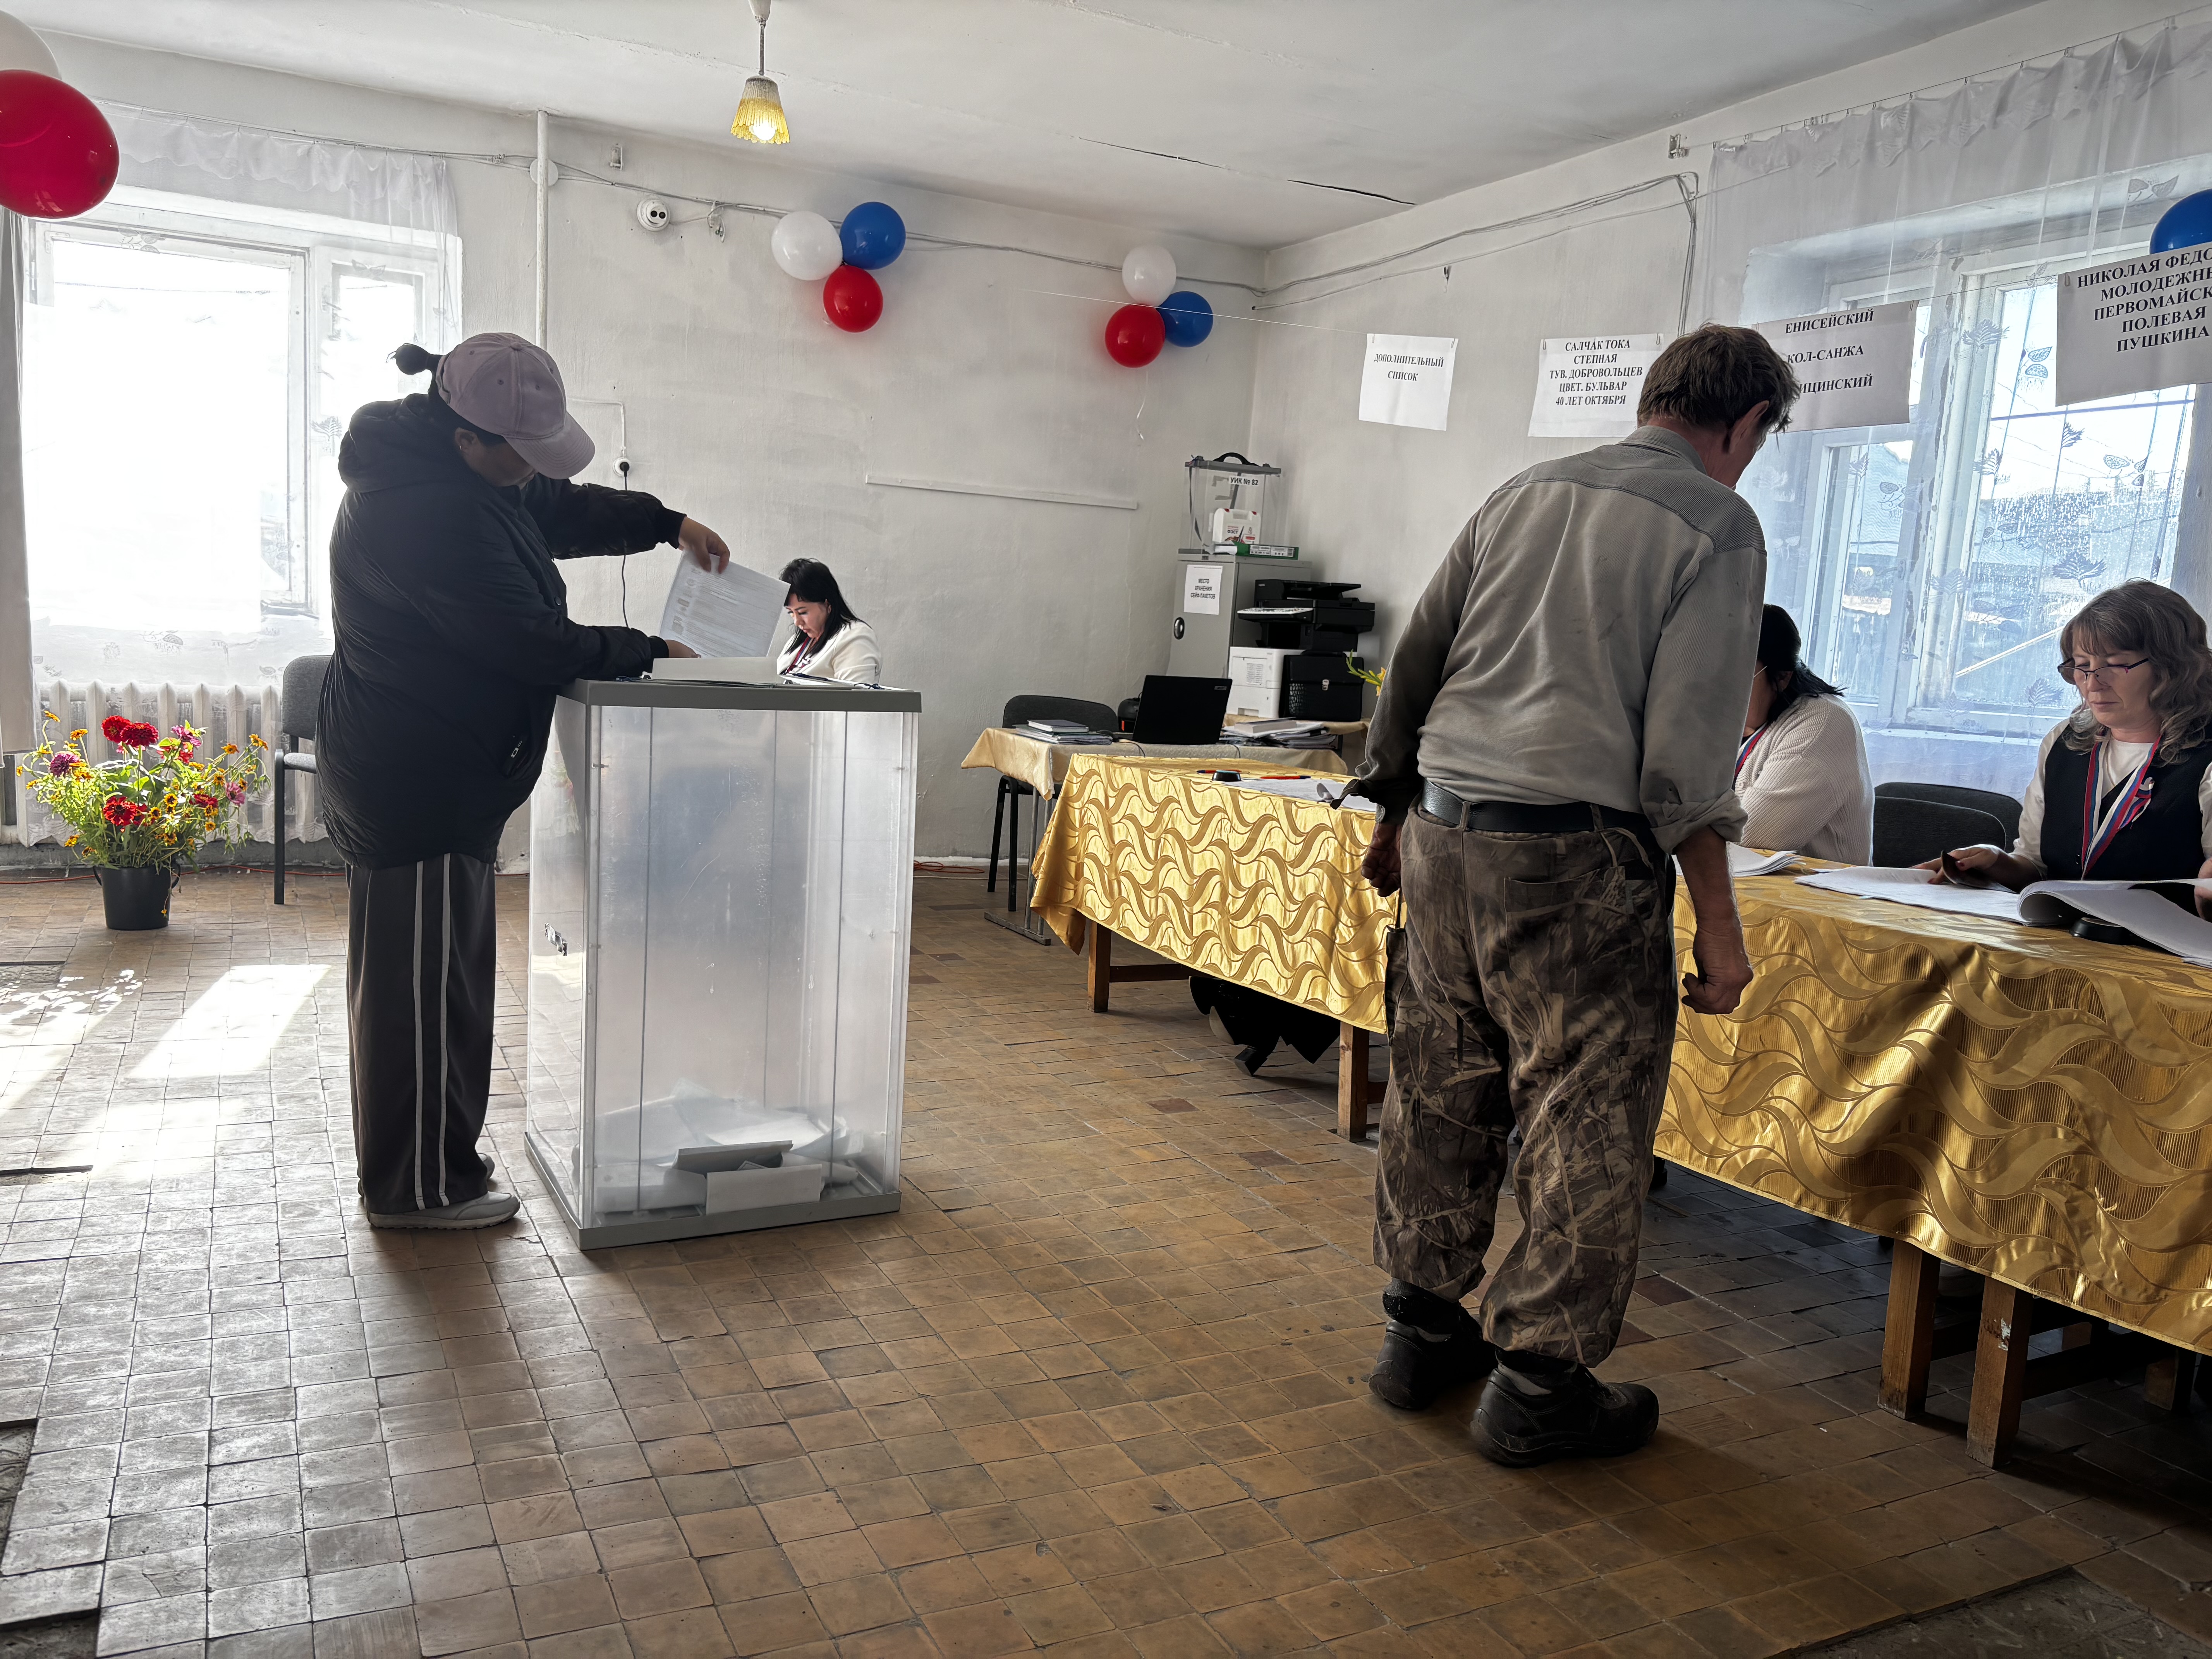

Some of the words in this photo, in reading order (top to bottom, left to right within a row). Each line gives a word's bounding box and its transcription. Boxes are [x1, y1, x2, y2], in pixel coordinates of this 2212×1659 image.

[2077, 259, 2161, 288] НИКОЛАЯ
[1785, 308, 1874, 333] ЕНИСЕЙСКИЙ
[2121, 306, 2207, 333] ПОЛЕВАЯ
[1565, 340, 1603, 351] САЛЧАК
[1606, 339, 1630, 349] ТОКА
[2116, 326, 2210, 352] ПУШКИНА
[1374, 354, 1444, 367] ДОПОЛНИТЕЛЬНЫЙ
[1574, 354, 1617, 364] СТЕПНАЯ
[1788, 345, 1863, 364] КОЛ-САНЖА
[1388, 371, 1418, 381] СПИСОК
[1550, 370, 1567, 379] ТУВ.
[1569, 367, 1643, 380] ДОБРОВОЛЬЦЕВ
[1559, 383, 1583, 393] ЦВЕТ.
[1585, 381, 1627, 391] БУЛЬВАР
[1800, 373, 1873, 394] ИЦИНСКИЙ
[1556, 397, 1564, 405] 40
[1565, 396, 1583, 405] ЛЕТ
[1585, 395, 1626, 405] ОКТЯБРЯ
